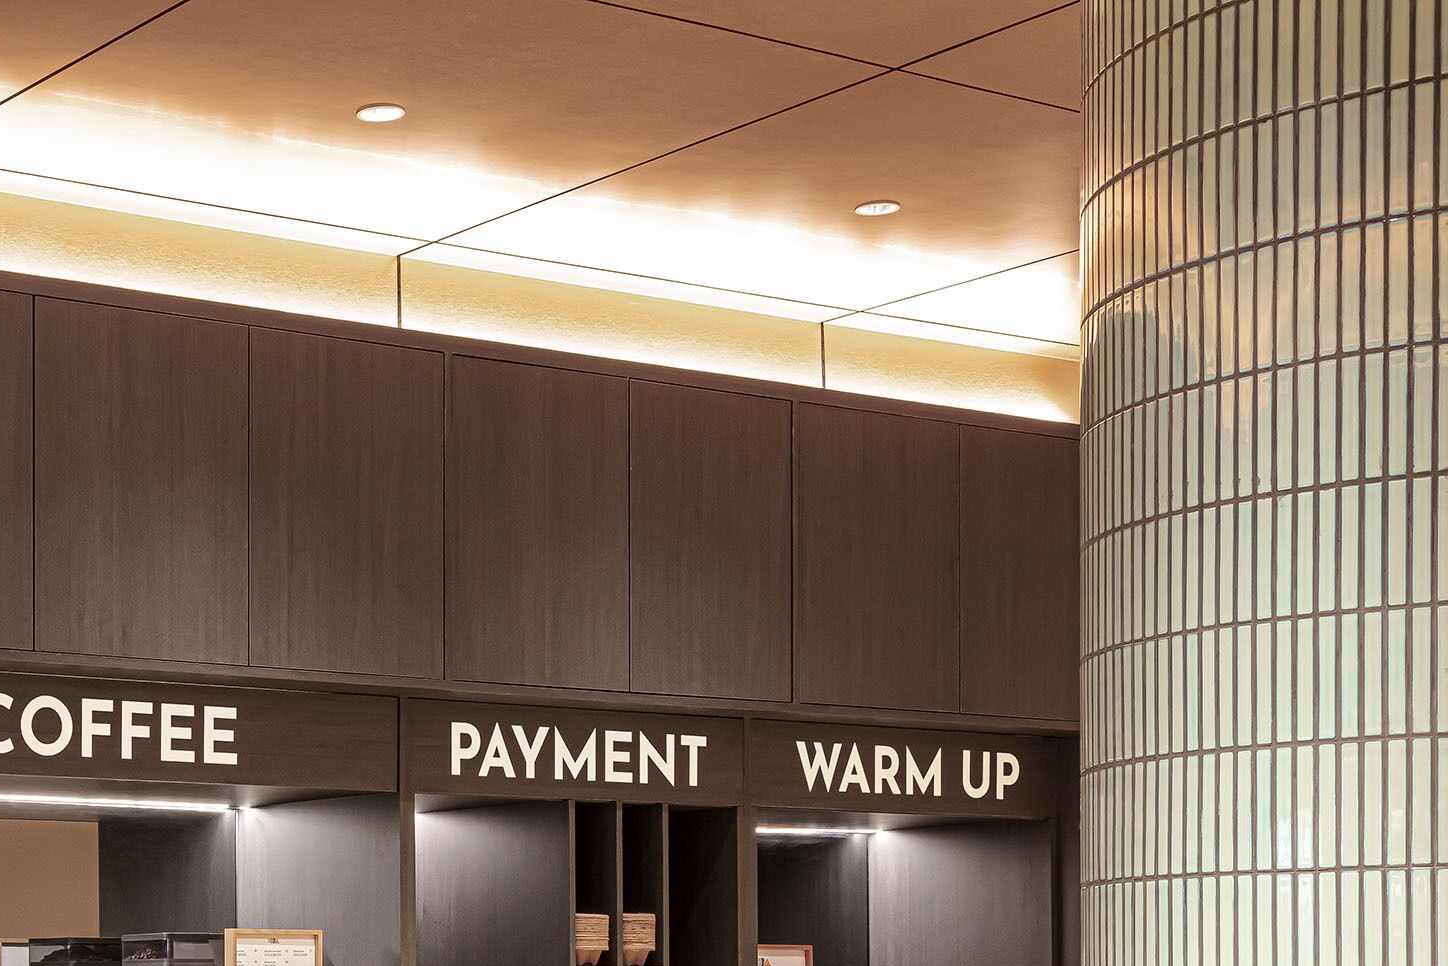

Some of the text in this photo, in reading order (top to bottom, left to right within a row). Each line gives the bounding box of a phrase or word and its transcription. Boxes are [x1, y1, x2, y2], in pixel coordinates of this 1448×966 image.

[451, 721, 708, 787] PAYMENT
[796, 740, 1021, 800] WARM UP
